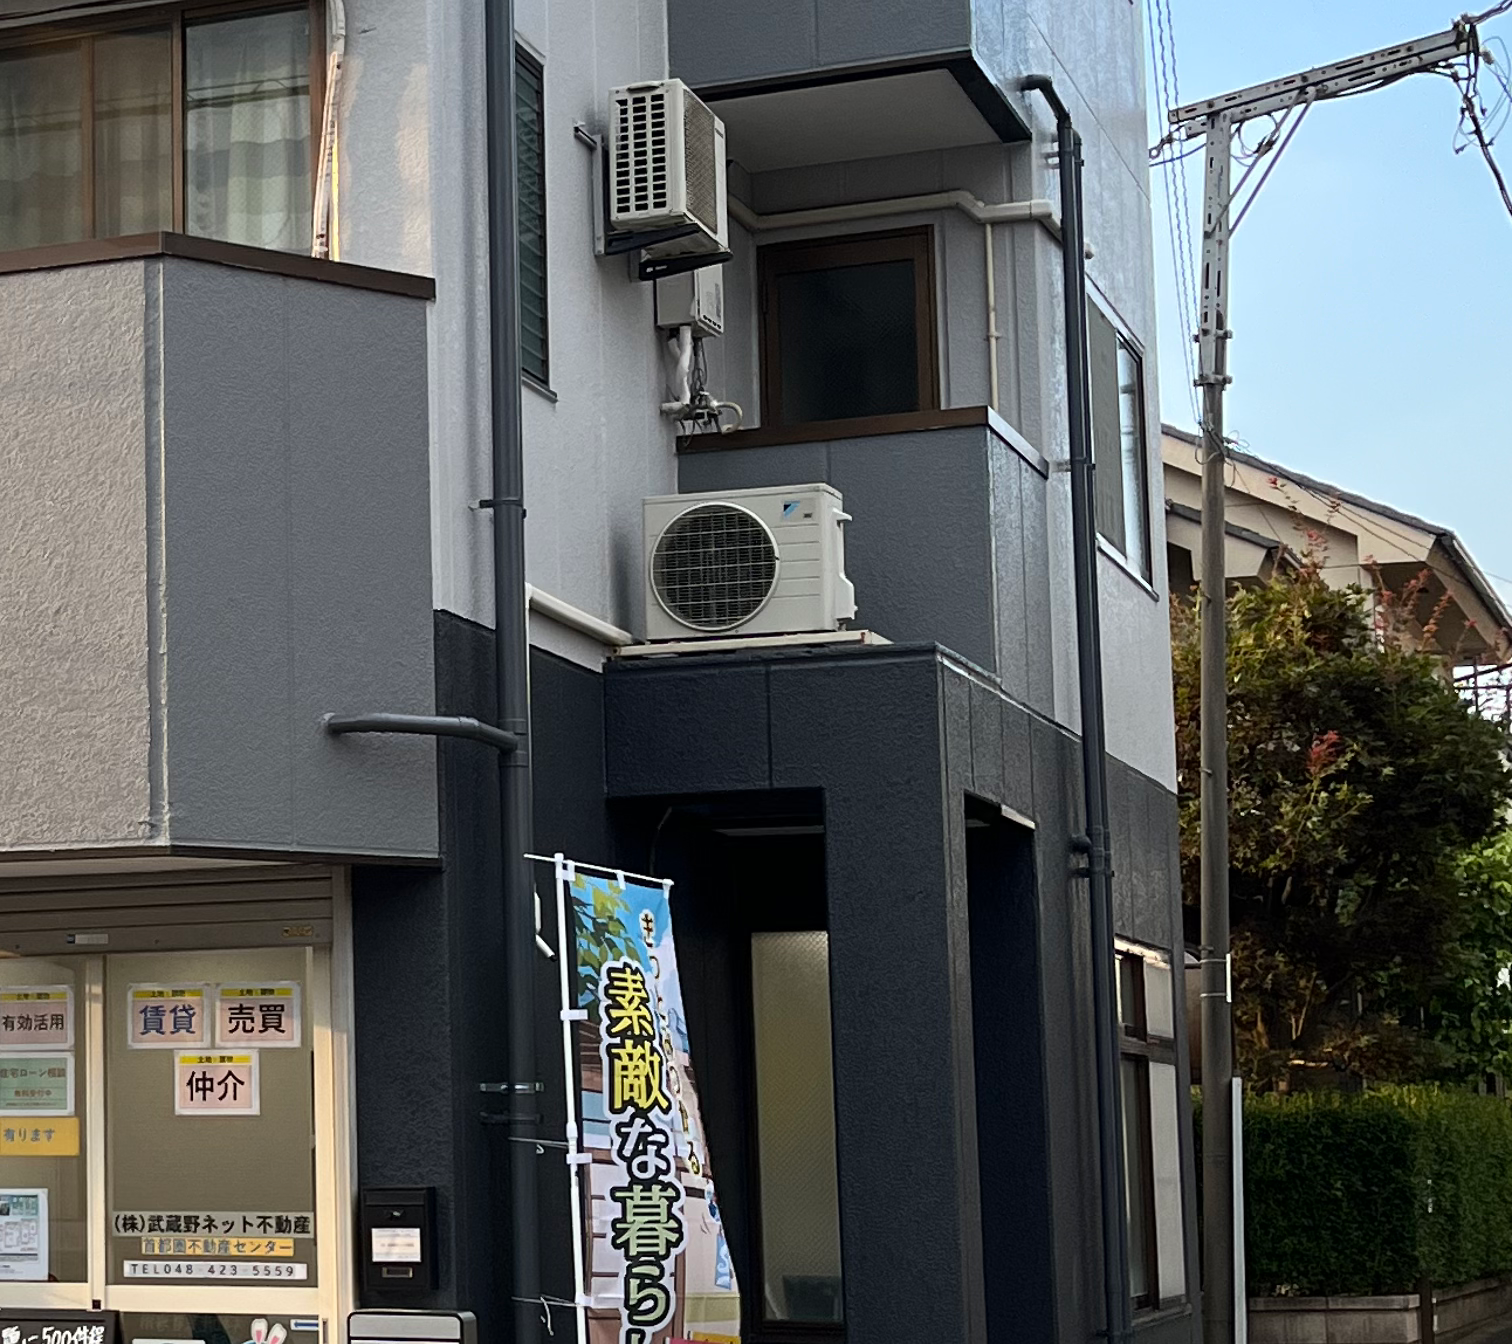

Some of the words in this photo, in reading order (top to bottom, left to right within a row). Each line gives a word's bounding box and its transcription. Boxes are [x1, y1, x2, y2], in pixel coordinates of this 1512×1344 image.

[2, 1013, 65, 1032] 有効活用
[139, 1004, 196, 1036] 賃貸
[228, 1003, 286, 1034] 売買
[186, 1069, 245, 1102] 仲介
[3, 1127, 56, 1142] 有ります
[114, 1213, 311, 1235] (株)武蔵野ネット不動産
[143, 1238, 293, 1255] 首都圏不動産センター
